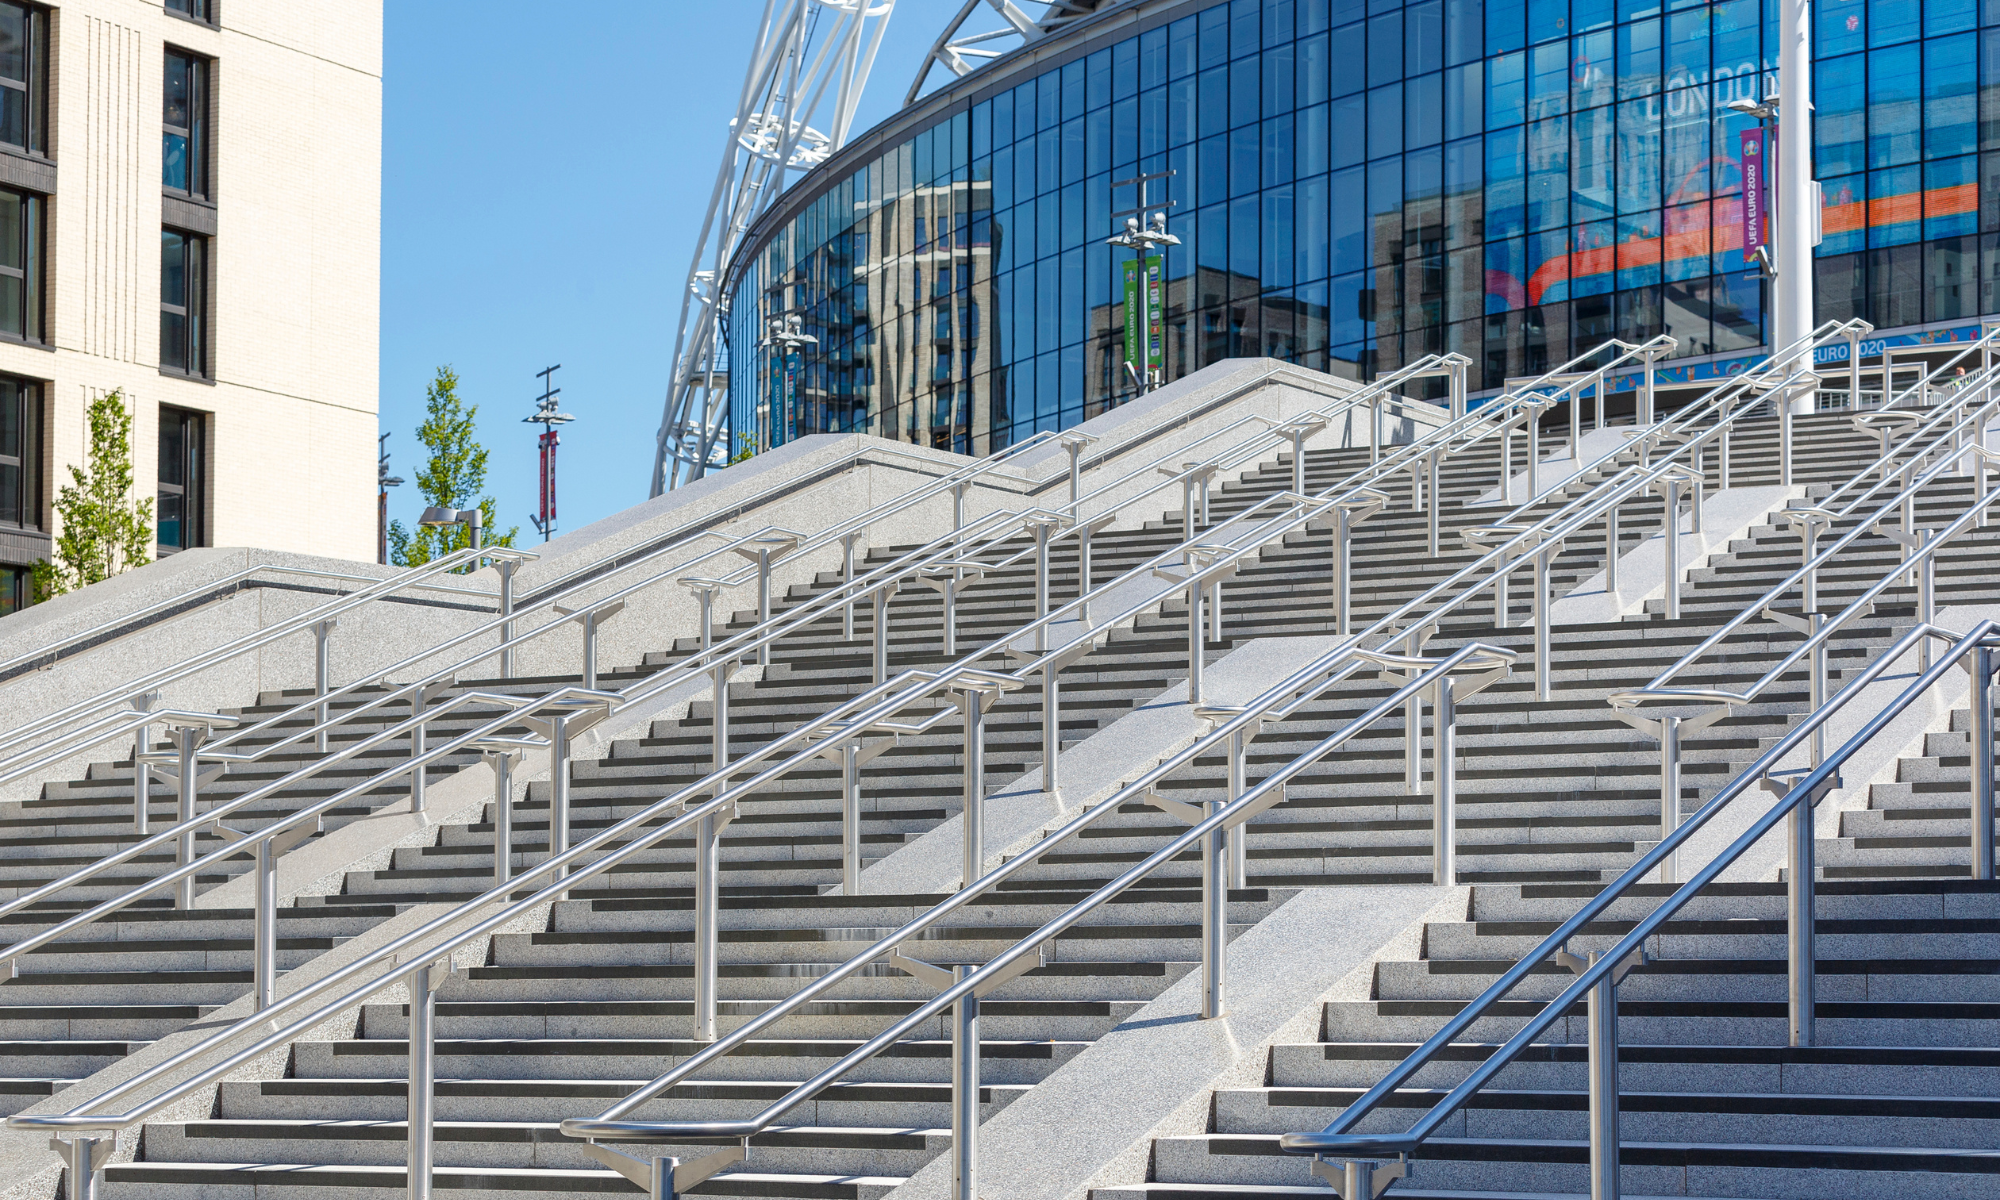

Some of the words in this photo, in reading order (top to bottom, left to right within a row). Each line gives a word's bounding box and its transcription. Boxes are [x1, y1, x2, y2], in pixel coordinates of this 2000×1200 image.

[1646, 56, 1780, 121] LONDON
[1747, 164, 1756, 190] 2020
[1748, 192, 1757, 218] EURO
[1749, 218, 1757, 245] UEFA
[1813, 345, 1848, 362] EURO
